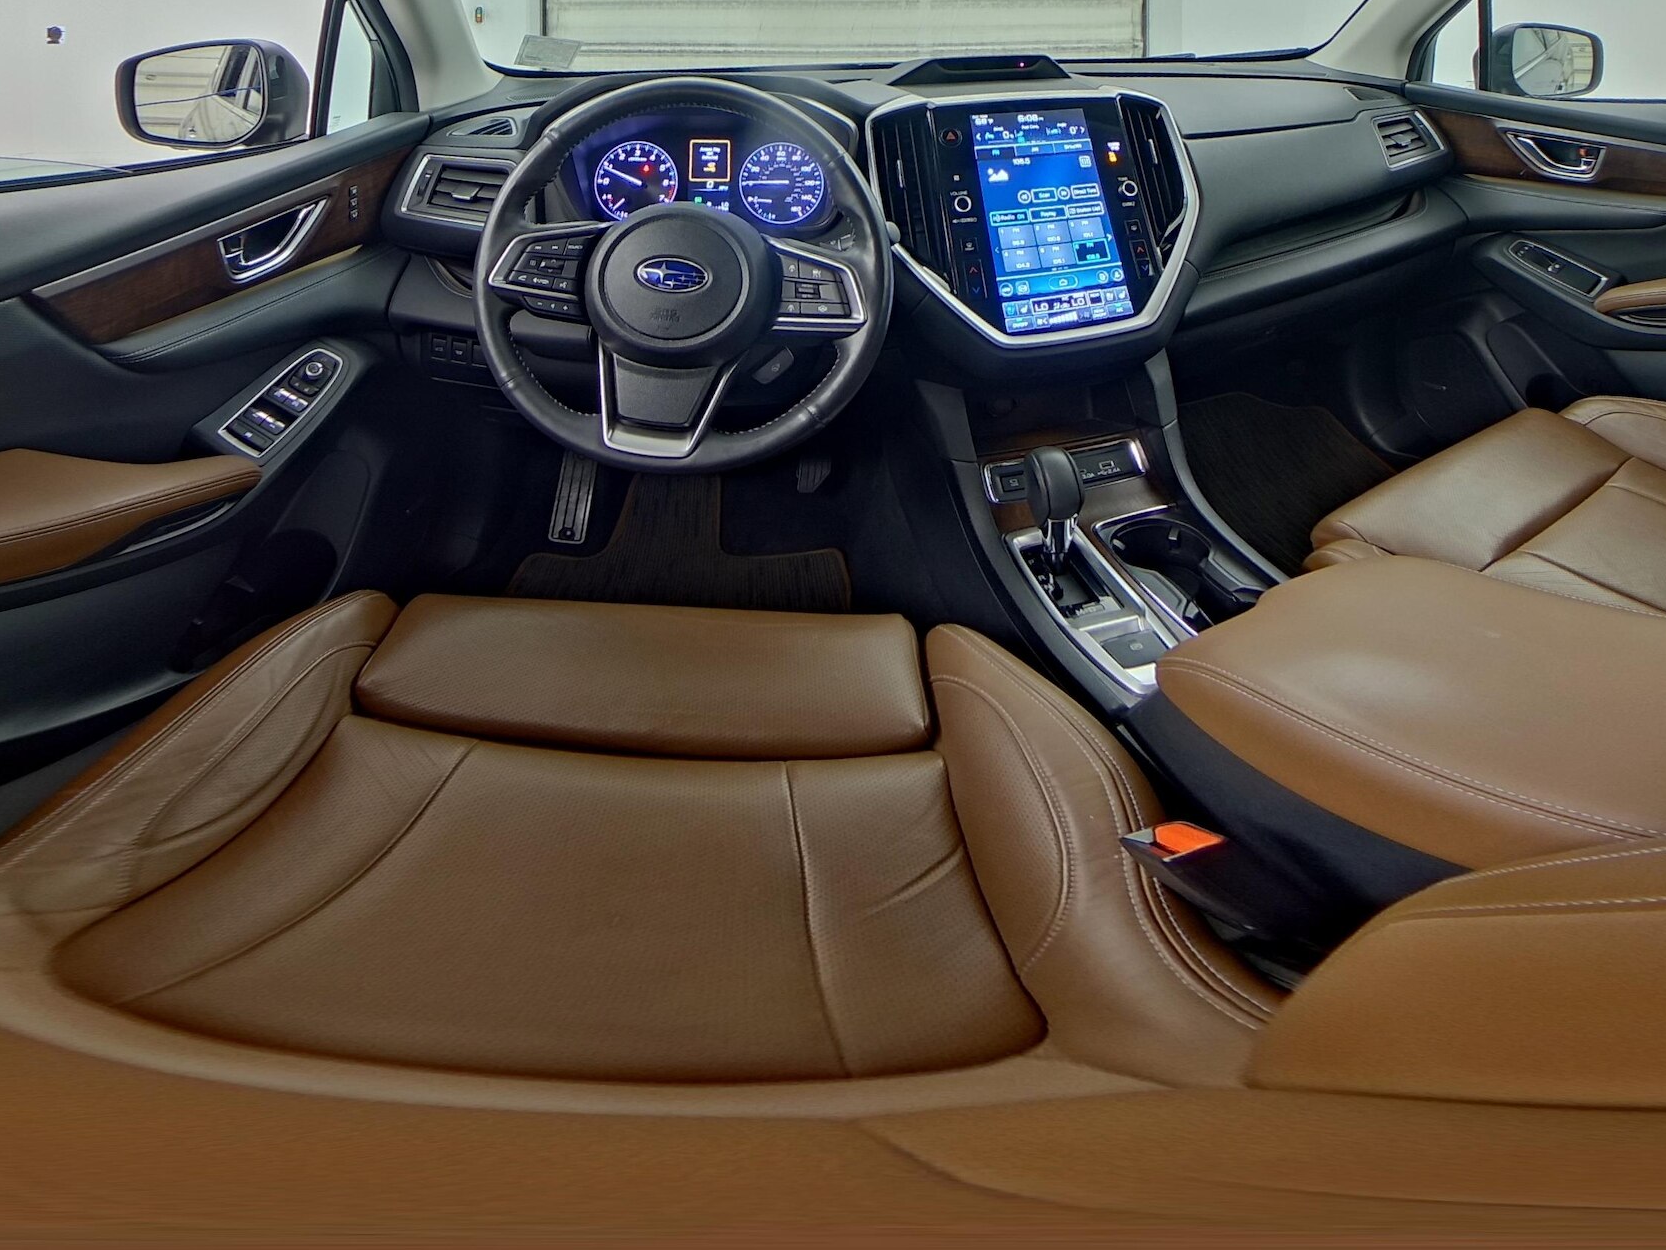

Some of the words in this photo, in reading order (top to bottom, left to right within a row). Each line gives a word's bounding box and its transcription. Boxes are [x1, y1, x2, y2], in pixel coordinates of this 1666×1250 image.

[706, 180, 714, 189] 0
[1034, 302, 1049, 312] LO
[1071, 297, 1086, 307] LO
